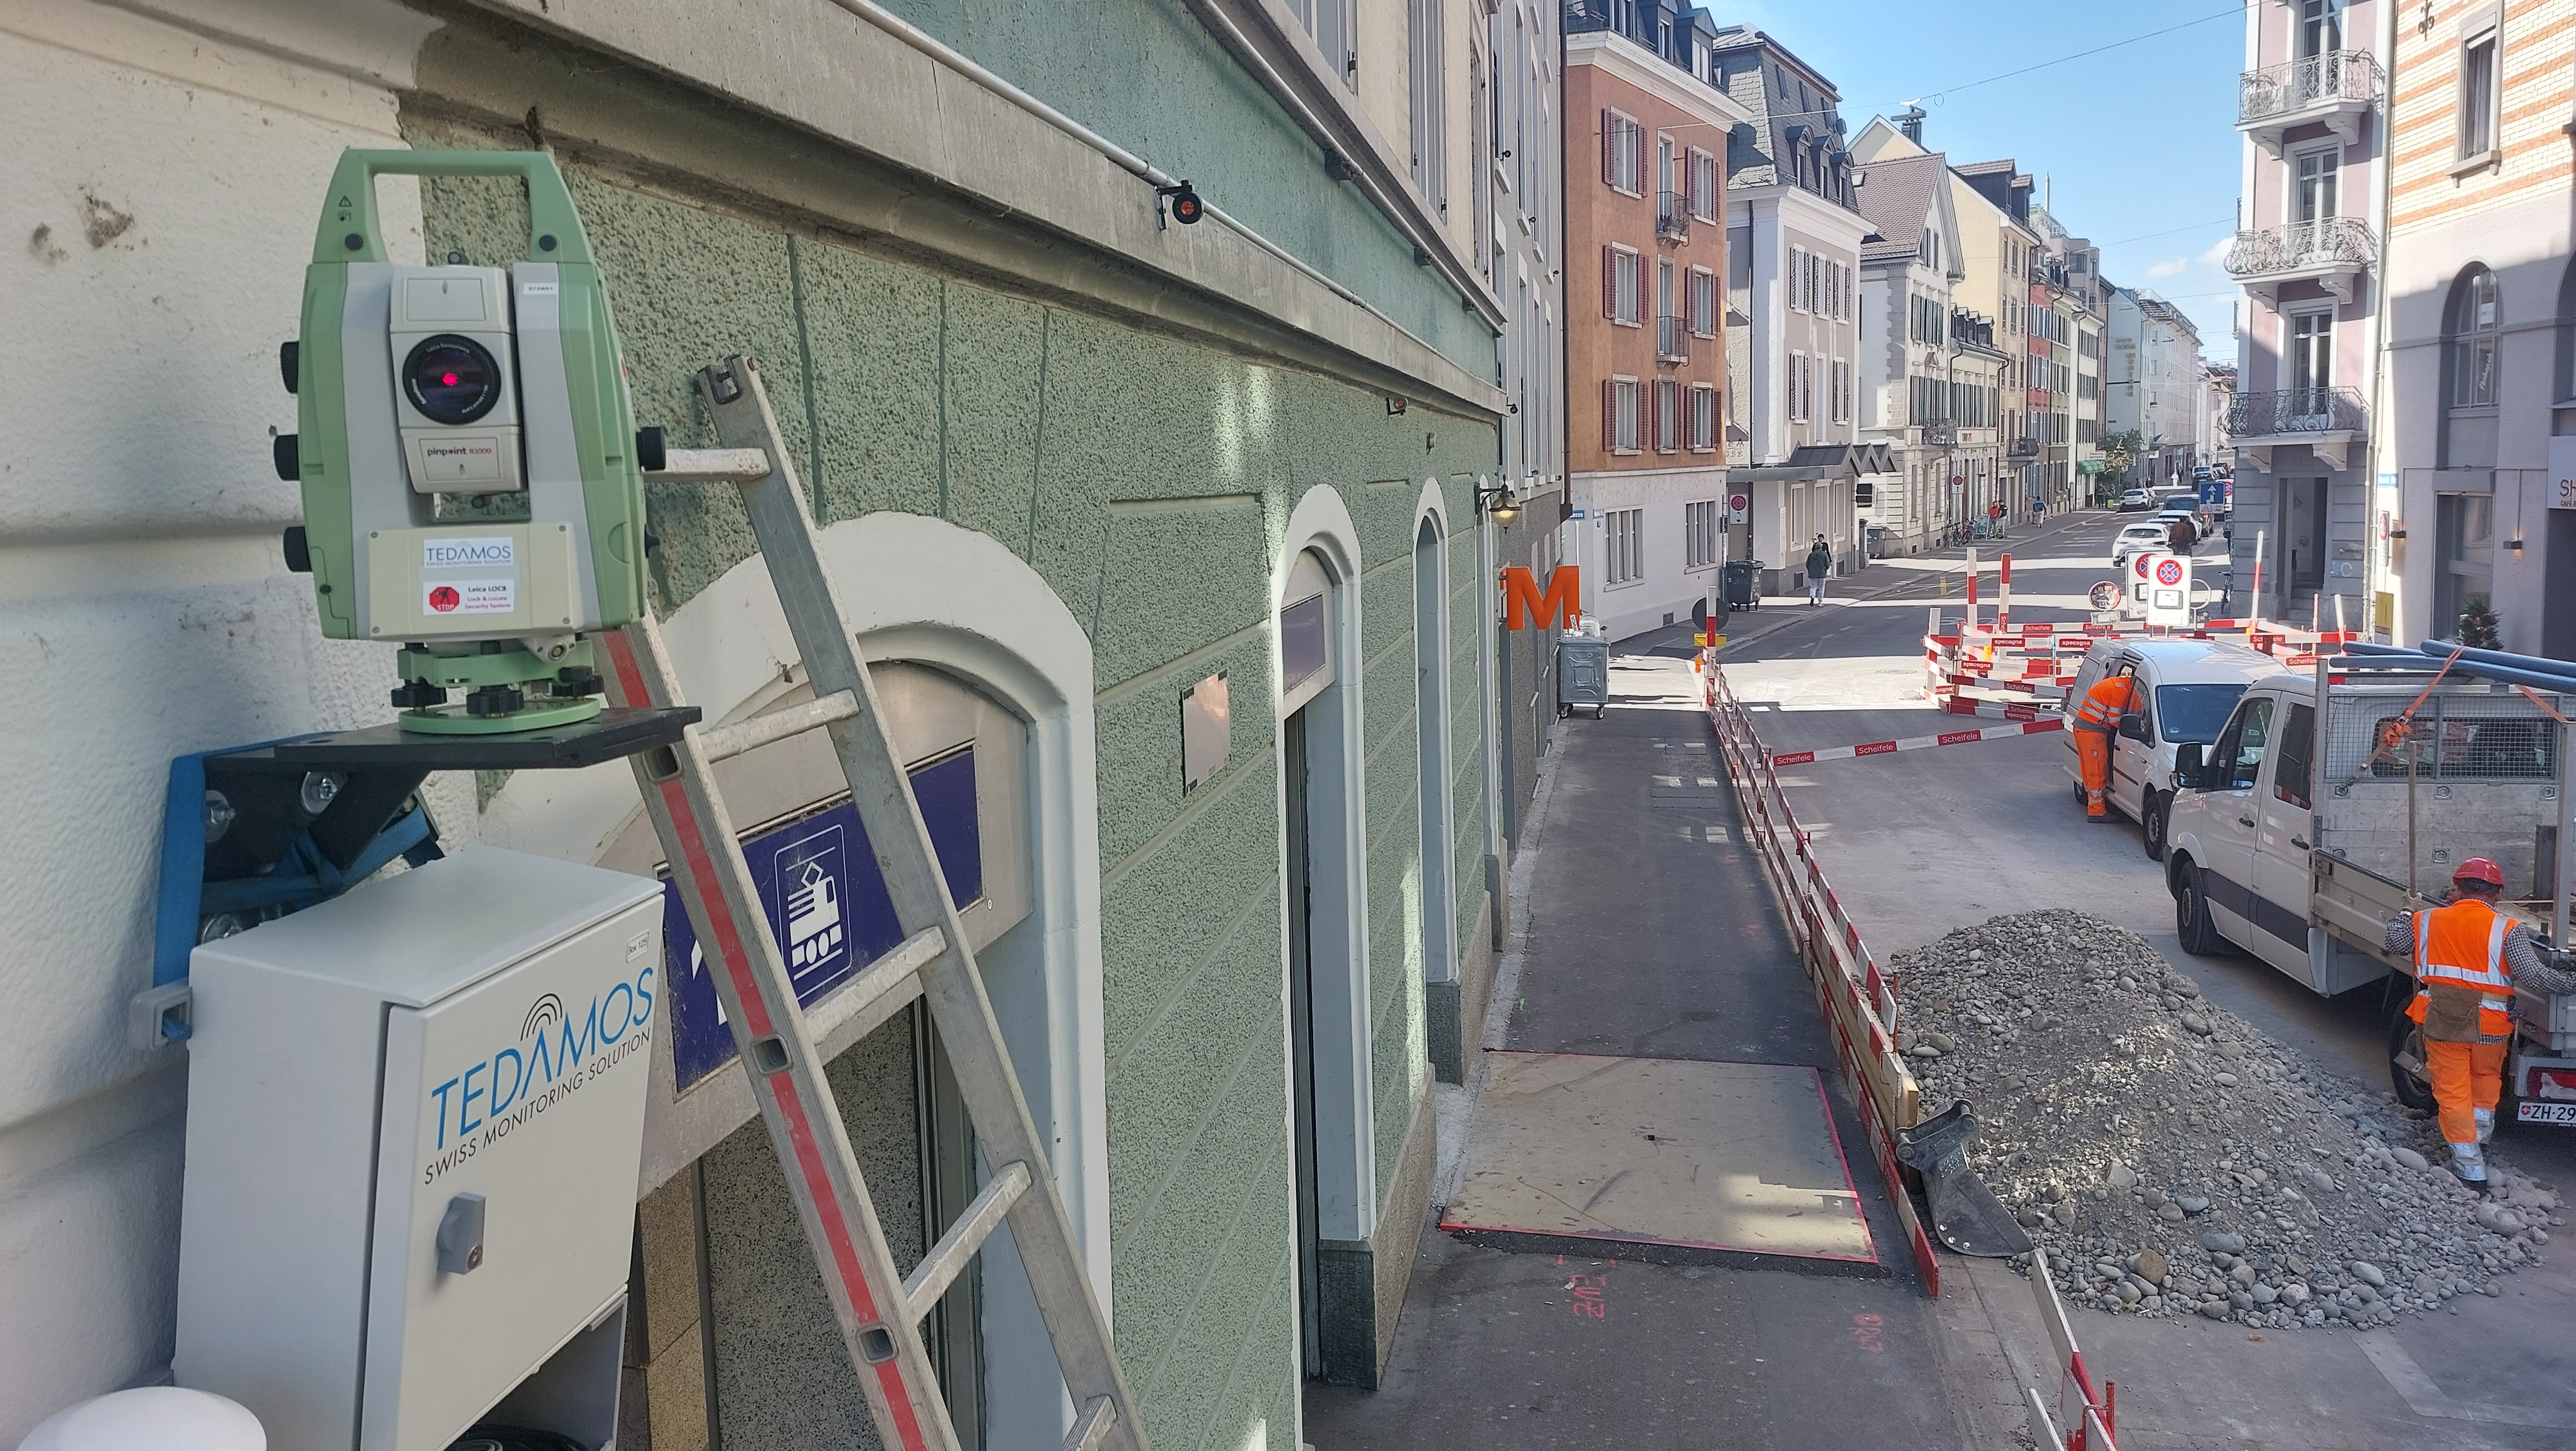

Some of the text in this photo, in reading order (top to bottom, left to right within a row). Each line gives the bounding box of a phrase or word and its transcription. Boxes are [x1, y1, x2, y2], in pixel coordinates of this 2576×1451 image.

[427, 447, 467, 457] pinpoint
[426, 546, 511, 561] TEDAMOS
[1506, 565, 1580, 631] M
[2007, 683, 2032, 692] Scheifele
[1942, 733, 1978, 744] Scheifele
[1858, 744, 1893, 754] Scheifele
[1777, 754, 1811, 765] Scheifele
[432, 967, 653, 1150] TEDAMOS
[425, 1026, 651, 1185] SWISS MONITORING SOLUTION
